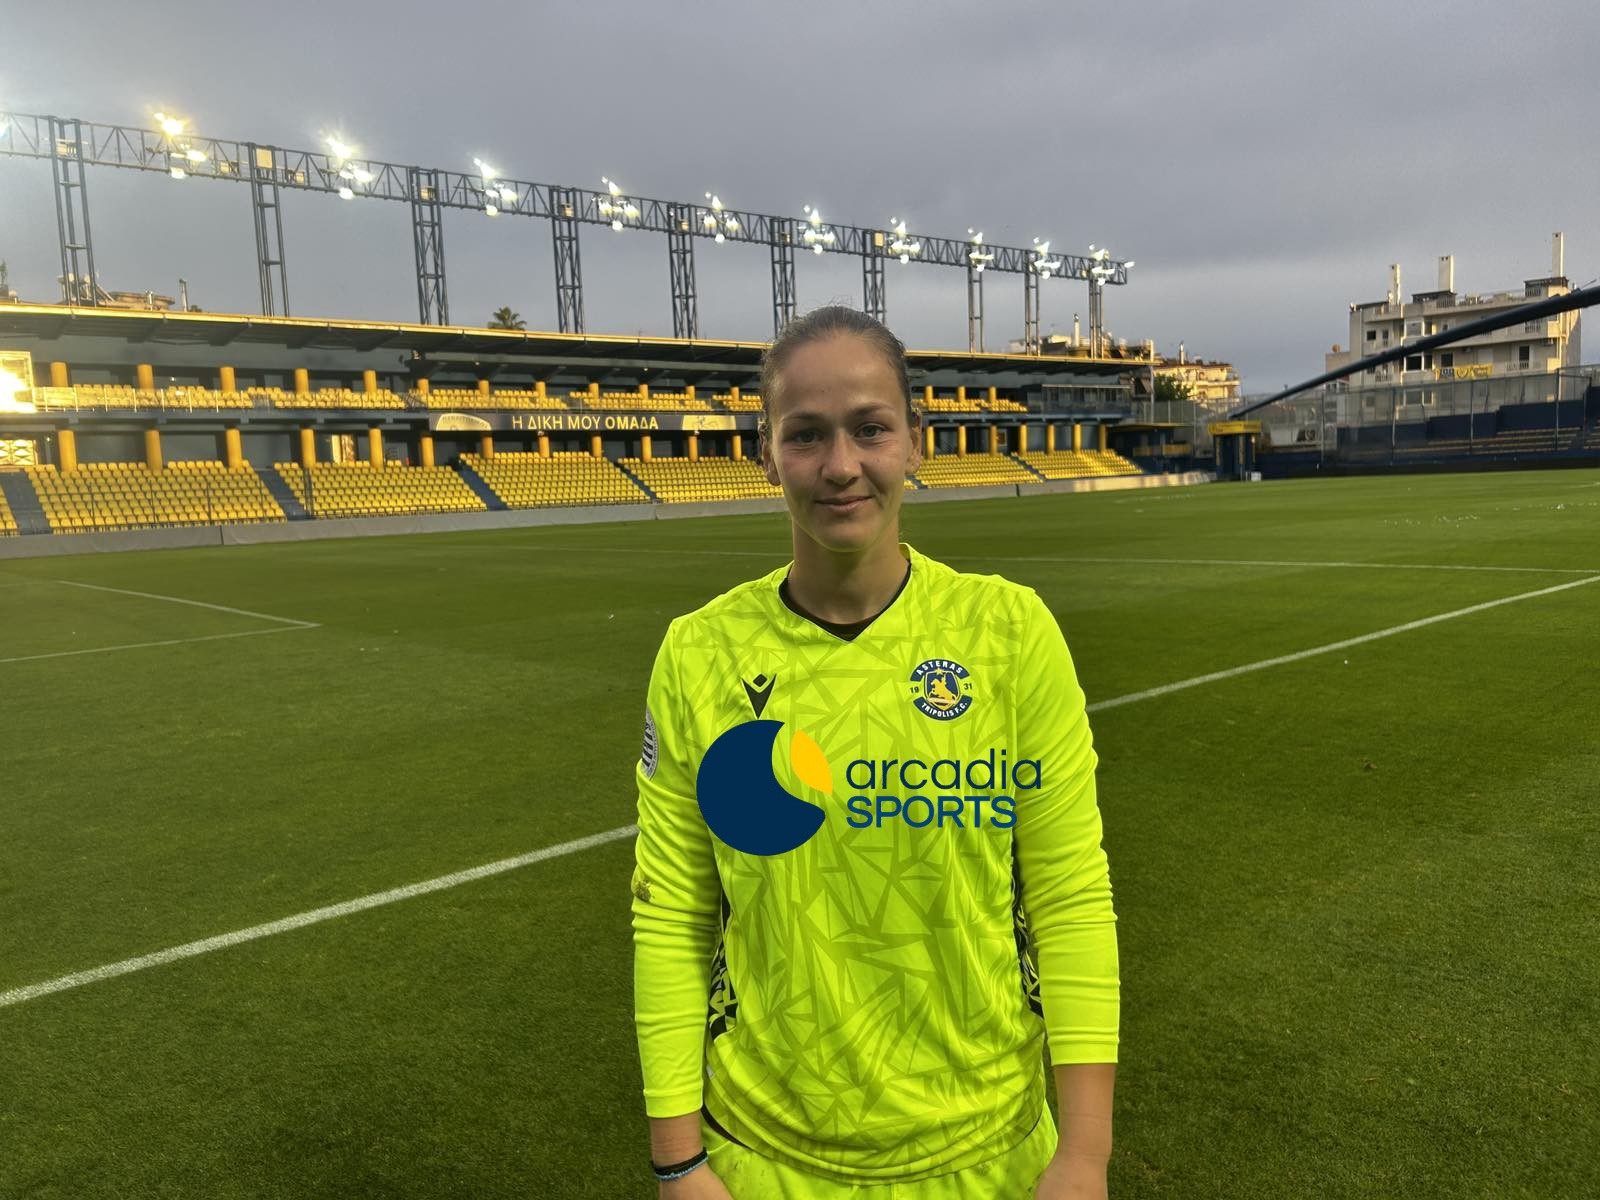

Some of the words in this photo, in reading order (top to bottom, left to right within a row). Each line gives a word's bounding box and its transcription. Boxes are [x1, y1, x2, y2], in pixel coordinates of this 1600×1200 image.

[512, 415, 523, 430] Η
[528, 415, 563, 430] ΔΙΚΗ
[568, 415, 600, 430] ΜΟΥ
[605, 415, 659, 430] ΟΜΑΔΑ
[916, 660, 963, 676] ASTERAS
[921, 702, 955, 718] TRIPOLIS
